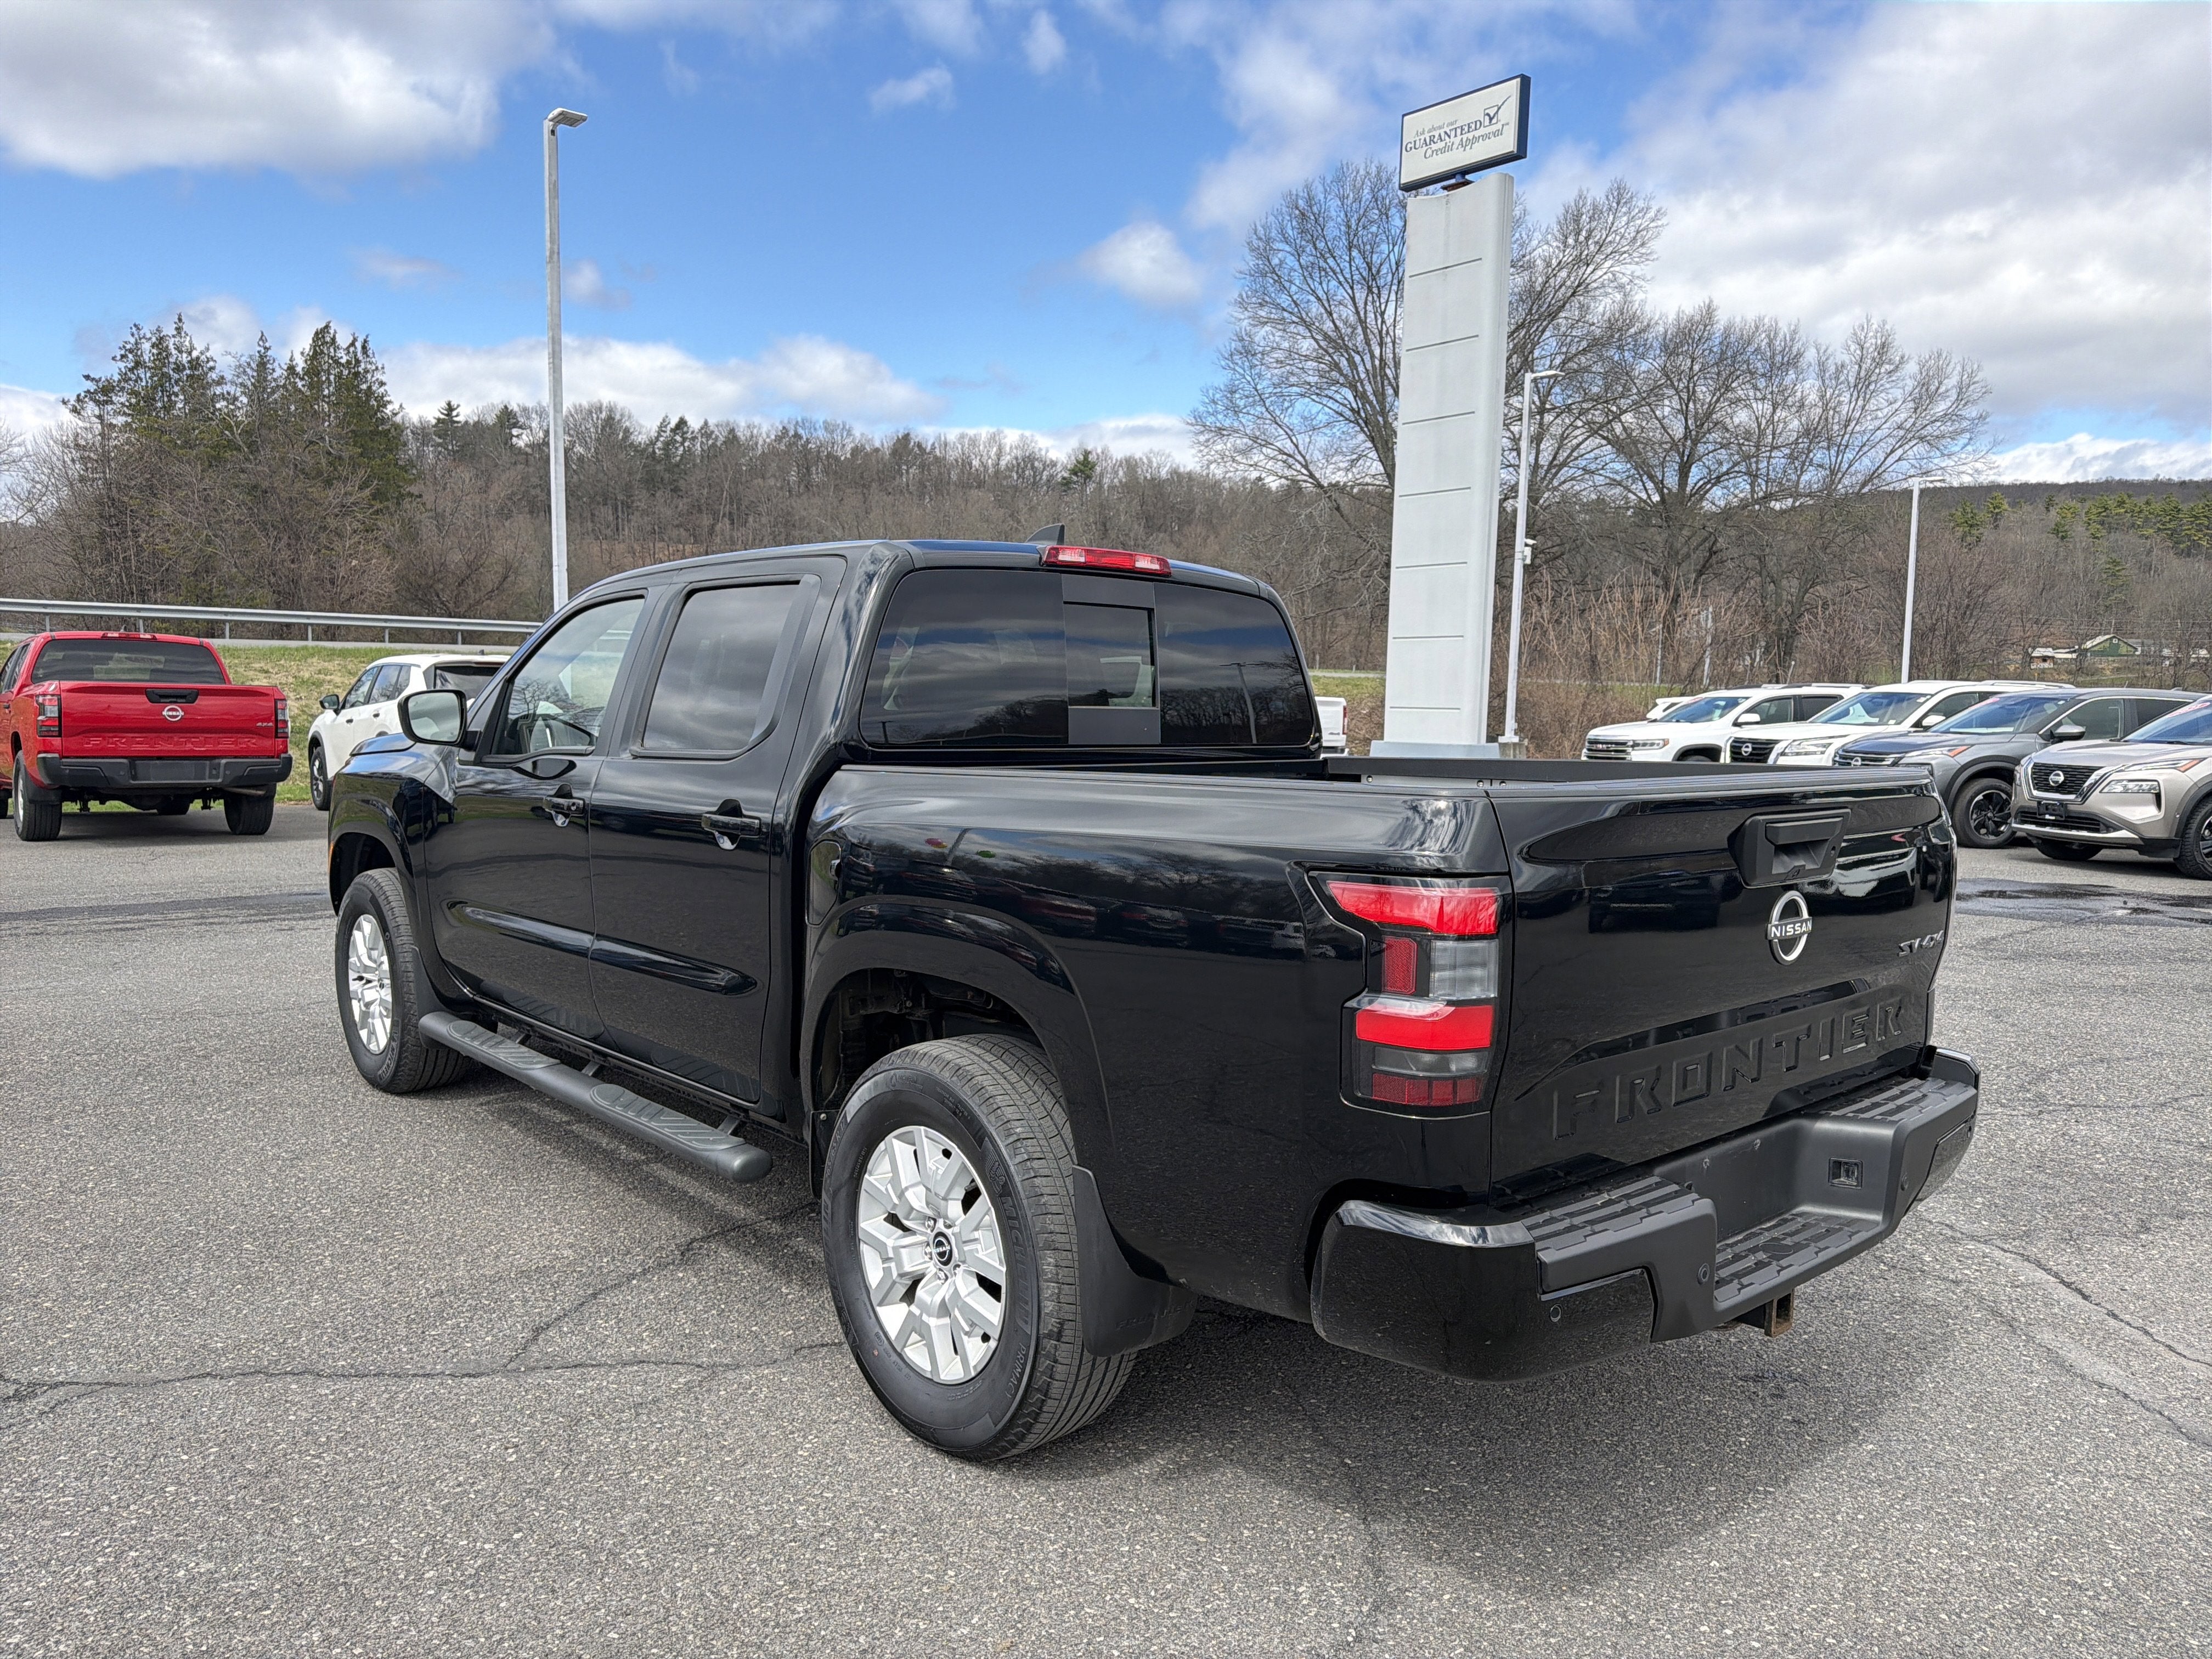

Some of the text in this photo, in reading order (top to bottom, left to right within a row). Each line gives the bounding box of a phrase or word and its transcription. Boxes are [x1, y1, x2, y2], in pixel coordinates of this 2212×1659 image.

[1404, 119, 1482, 153] GUARANTEED
[1414, 119, 1458, 138] Ask about our
[1424, 140, 1454, 159] Credit
[1771, 920, 1812, 938] NISSAN
[1552, 994, 1903, 1141] FRONTIER
[1005, 1342, 1026, 1398] PRIMACY
